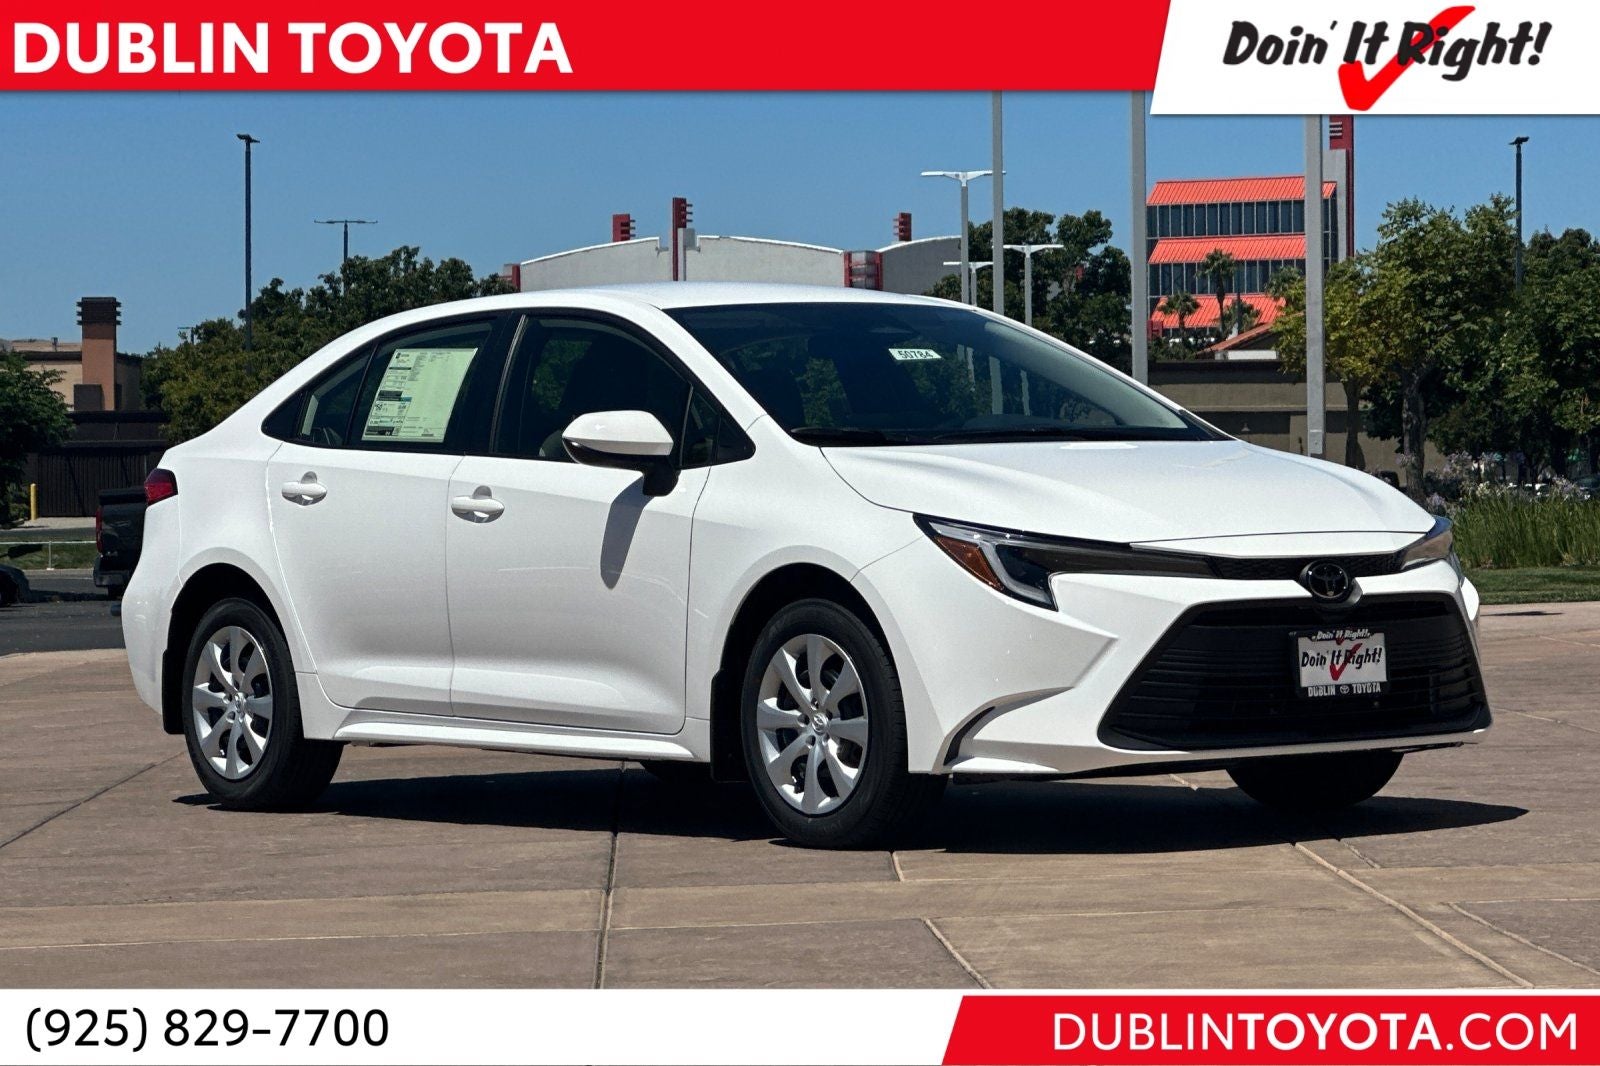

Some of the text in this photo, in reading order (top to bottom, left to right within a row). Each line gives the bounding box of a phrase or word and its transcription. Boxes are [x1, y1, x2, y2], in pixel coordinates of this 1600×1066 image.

[897, 350, 934, 359] 50784
[1301, 647, 1382, 669] Doin' It Right!
[1308, 682, 1381, 697] DUBLIN TOYOTA
